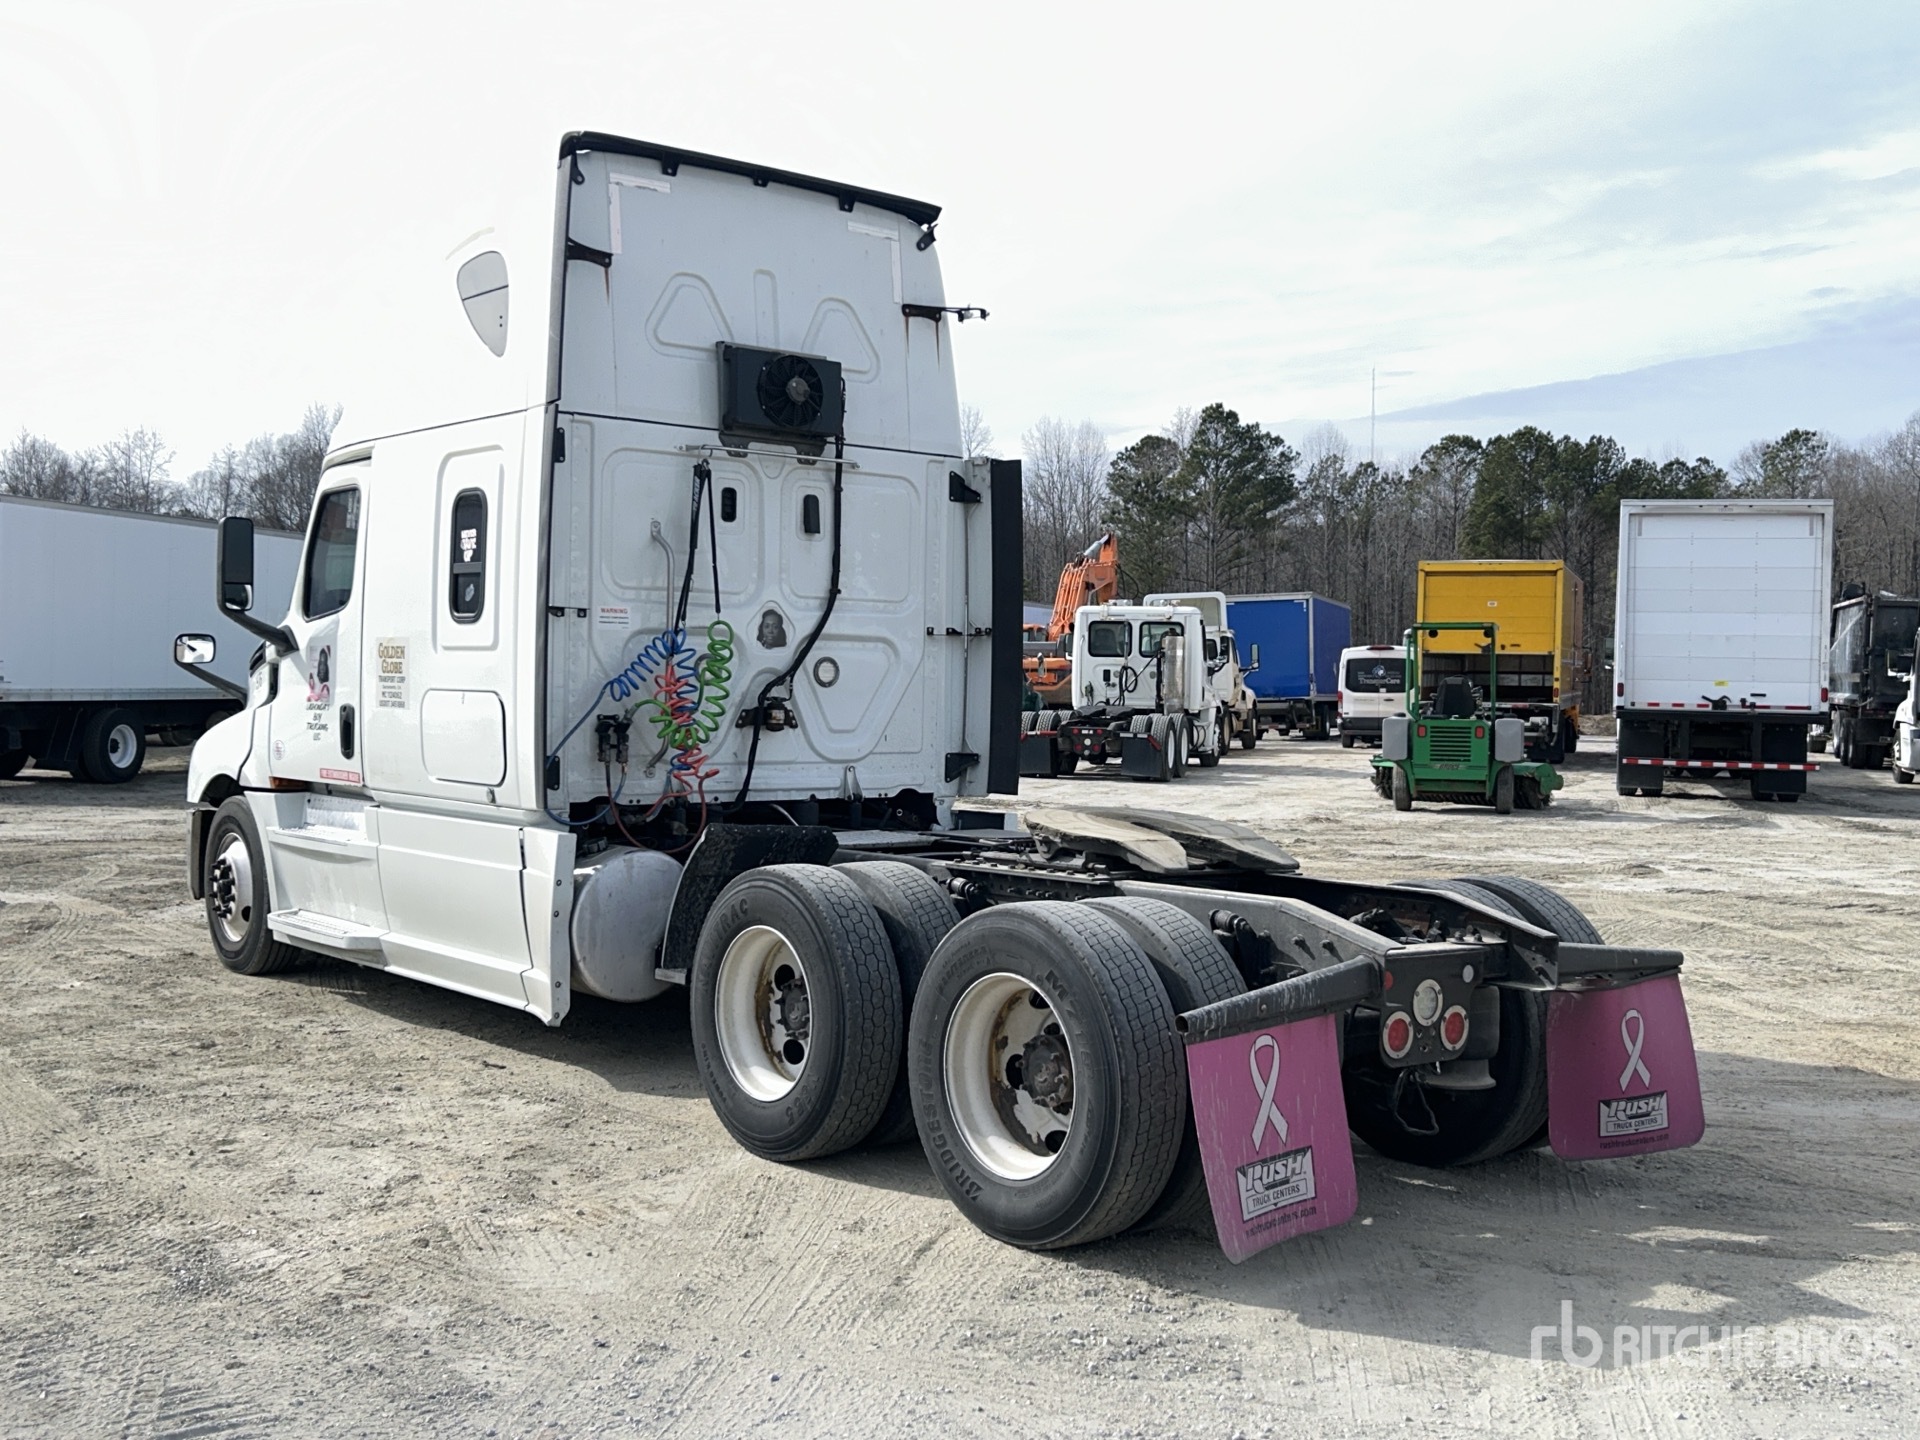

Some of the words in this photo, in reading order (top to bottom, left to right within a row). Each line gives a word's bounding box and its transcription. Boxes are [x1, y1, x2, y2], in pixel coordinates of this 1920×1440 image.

[600, 607, 628, 615] WARNING
[378, 642, 406, 660] GOLDEN
[381, 659, 403, 674] GLOBE
[1608, 1097, 1662, 1121] RUSH
[918, 1037, 984, 1203] BRIDGESTONE
[1613, 1121, 1633, 1130] TRUCK
[1633, 1117, 1658, 1127] CENTERS
[1246, 1153, 1305, 1194] RUSH
[1252, 1193, 1272, 1208] TRUCK
[1272, 1184, 1301, 1200] CENTERS
